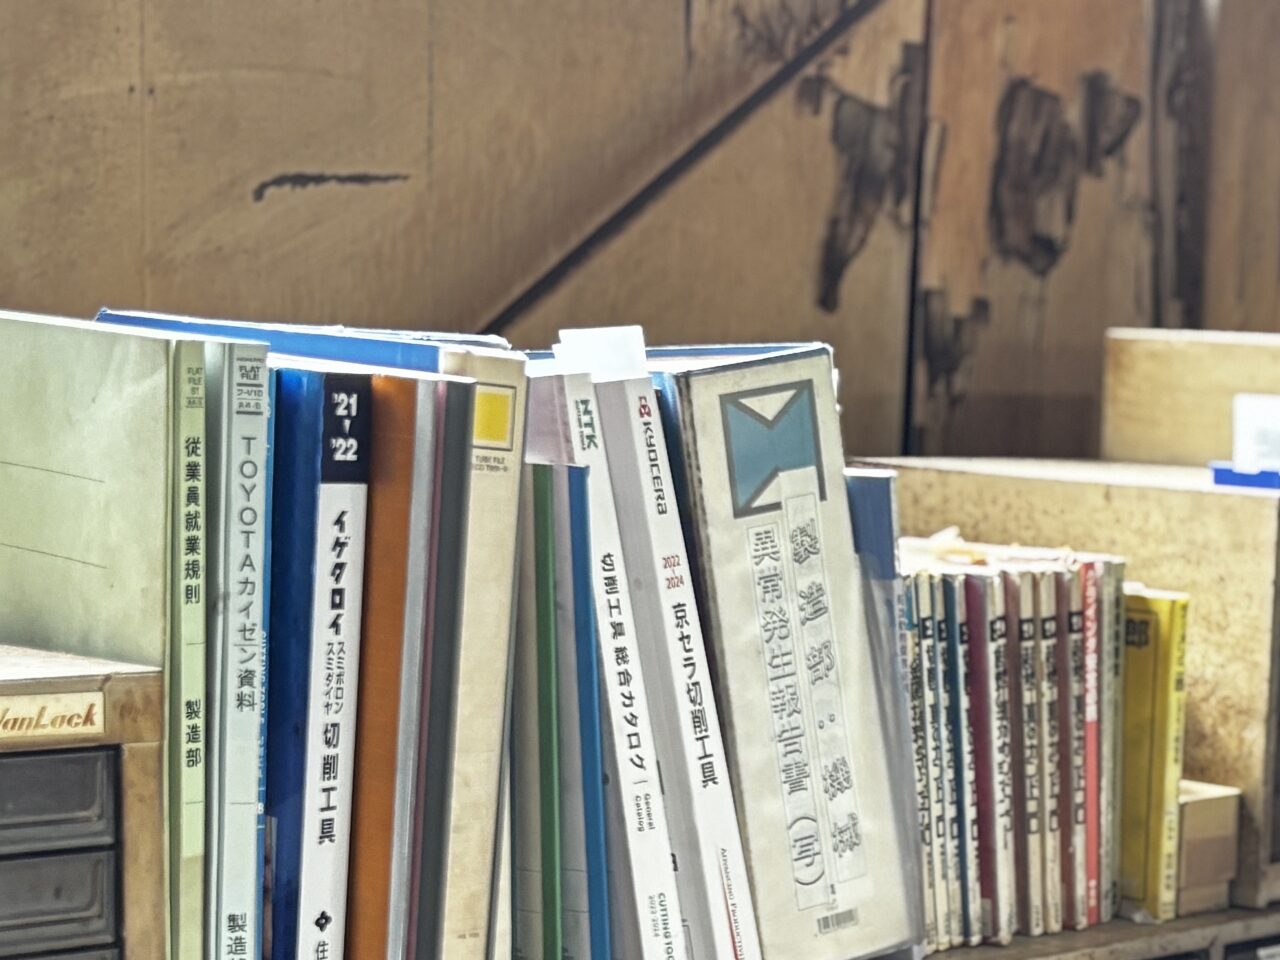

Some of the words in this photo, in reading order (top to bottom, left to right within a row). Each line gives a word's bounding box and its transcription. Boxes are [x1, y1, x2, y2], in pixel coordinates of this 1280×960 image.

[580, 400, 598, 449] NTK
[643, 421, 667, 516] KYOCERA
[184, 436, 202, 605] 従業員就業規則
[662, 555, 681, 569] 2022
[236, 437, 259, 712] TOYOTAカイゼン資料
[329, 511, 350, 635] イゲタロイ
[666, 576, 685, 589] 2024
[600, 552, 626, 640] 切削工具
[614, 646, 647, 771] 総合カタログ
[0, 703, 97, 732] anLock
[184, 700, 202, 767] 製造部
[318, 722, 341, 844] 切削工具
